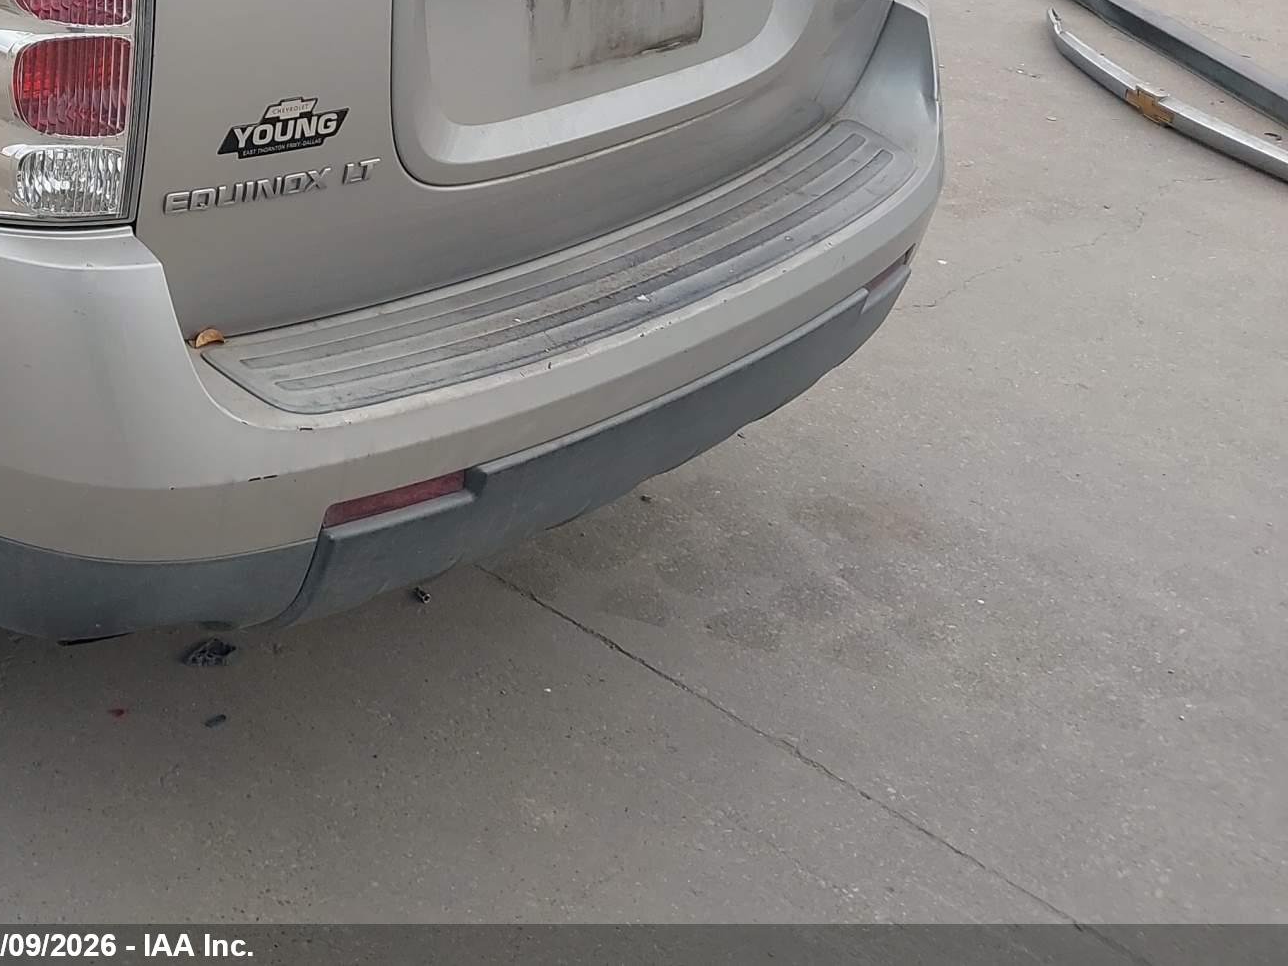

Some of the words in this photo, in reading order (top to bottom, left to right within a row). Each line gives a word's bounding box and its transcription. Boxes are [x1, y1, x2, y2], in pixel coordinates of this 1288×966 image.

[272, 104, 310, 115] CHEVROLET
[234, 113, 338, 148] YOUNG
[163, 167, 331, 215] EQUINOX
[342, 158, 381, 185] LT
